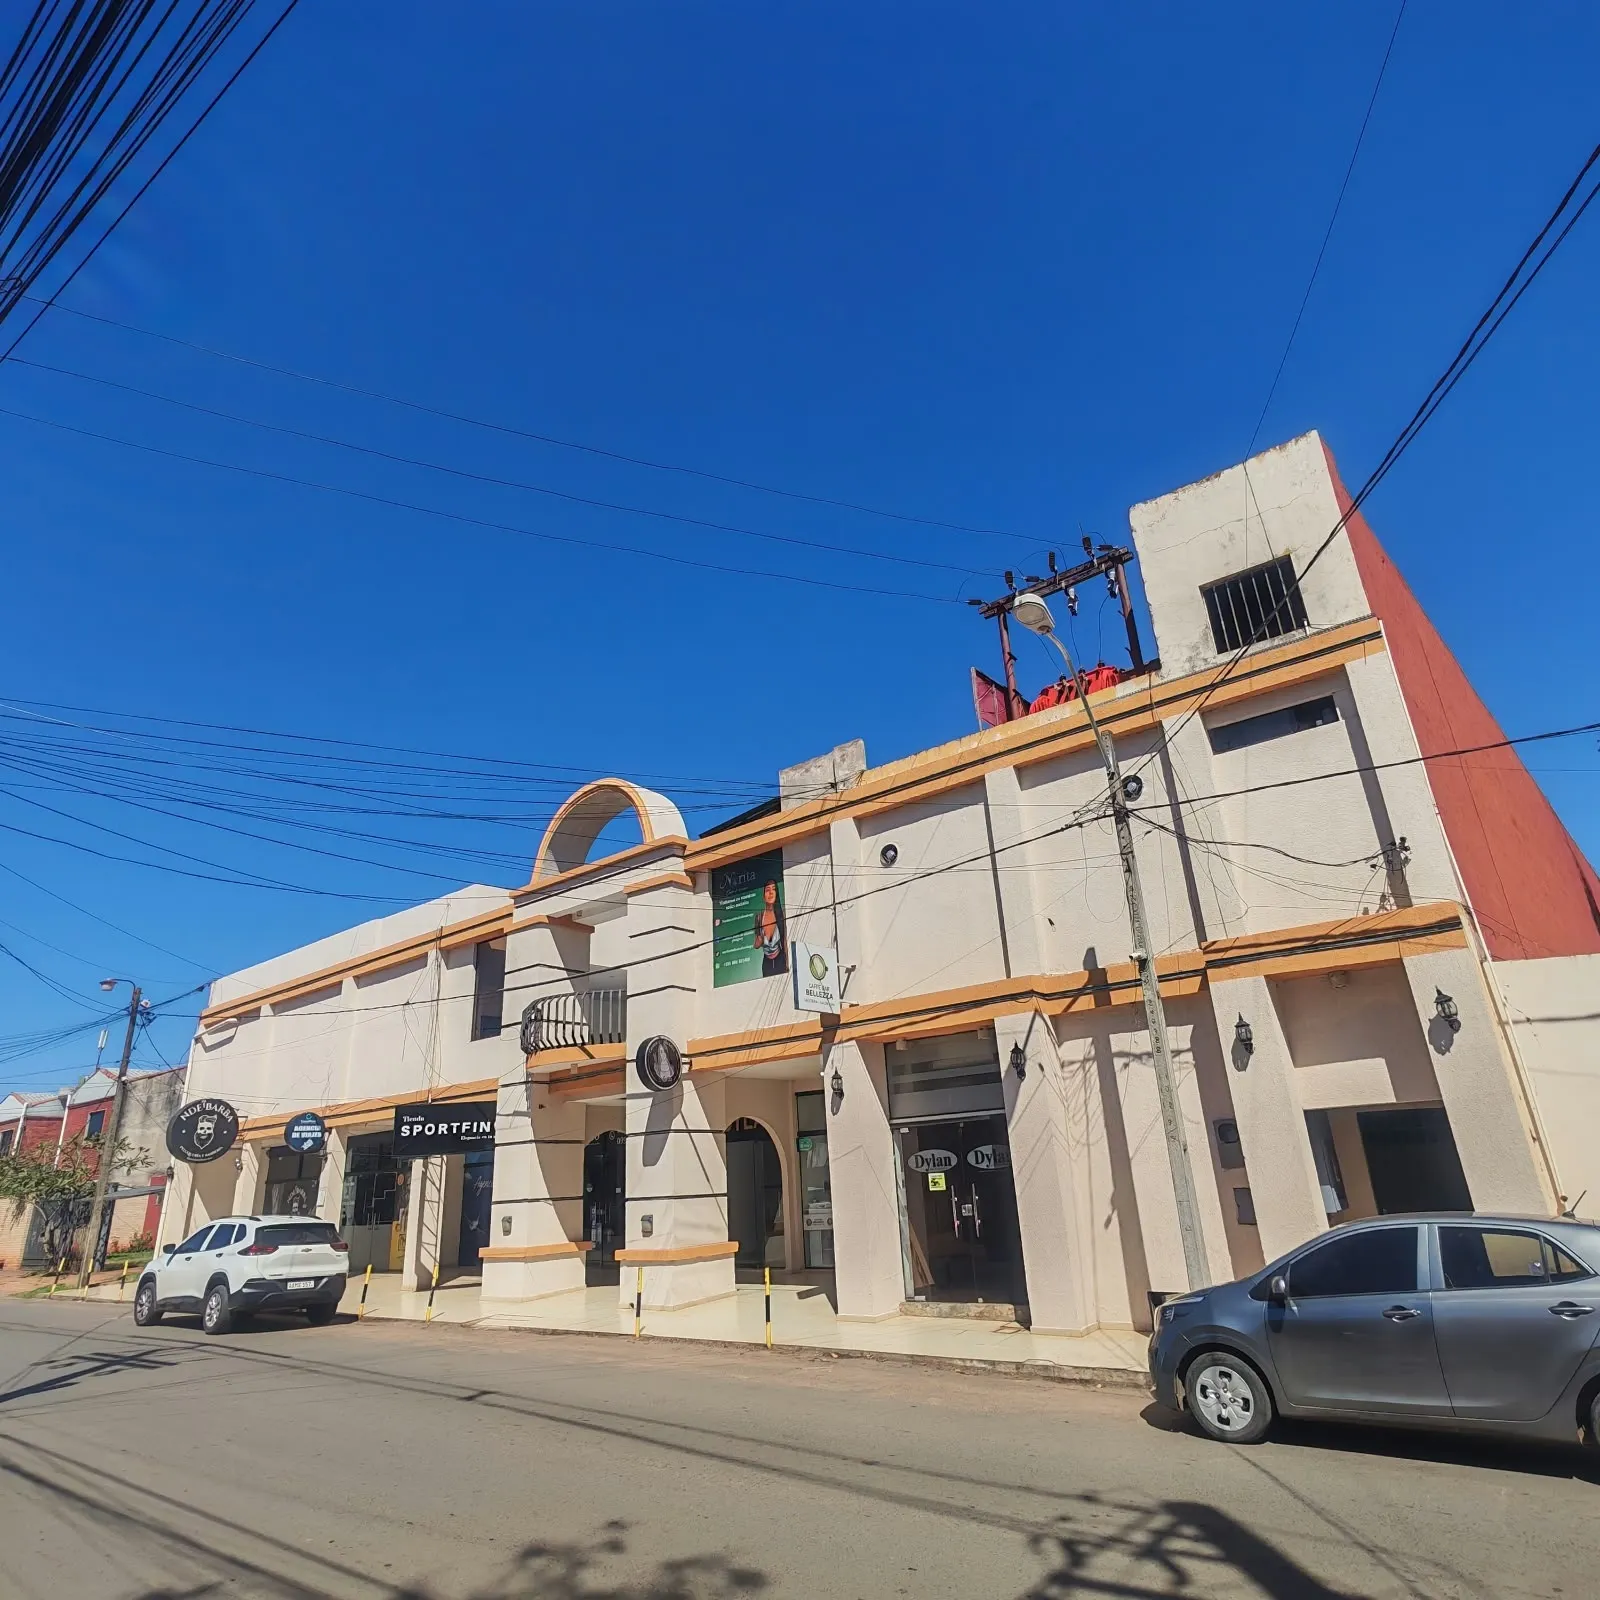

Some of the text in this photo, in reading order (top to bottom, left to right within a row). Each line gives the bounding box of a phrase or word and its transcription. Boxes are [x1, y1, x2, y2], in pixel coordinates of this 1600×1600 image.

[805, 989, 834, 1000] BELLEZZA
[205, 1103, 234, 1123] BARBA
[400, 1121, 494, 1137] SPORTFIN
[914, 1153, 953, 1172] Dylan
